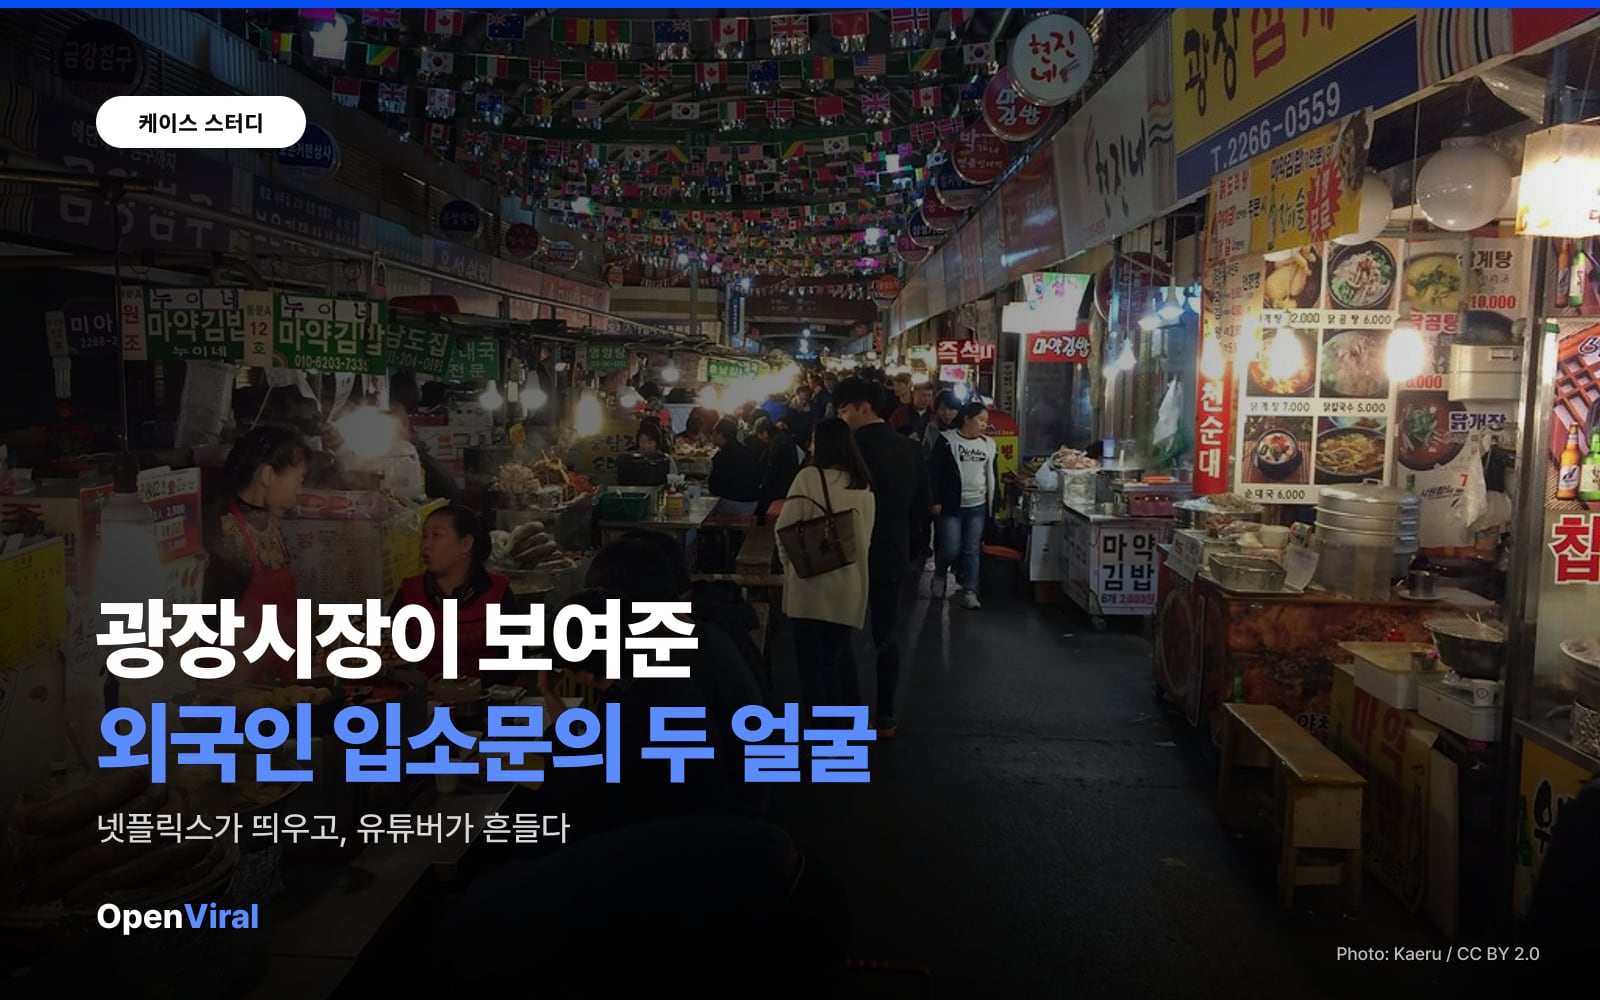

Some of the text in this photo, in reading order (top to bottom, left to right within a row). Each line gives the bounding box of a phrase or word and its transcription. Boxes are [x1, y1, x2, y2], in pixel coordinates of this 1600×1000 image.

[63, 41, 133, 73] 금강침구
[1210, 81, 1340, 174] T.2266-0559
[152, 287, 240, 310] 누이네
[282, 295, 372, 324] 누이네
[122, 304, 142, 352] 원조
[1260, 312, 1282, 324] 계탕
[171, 345, 228, 358] 누이네
[279, 318, 385, 358] 마약김밥
[387, 323, 449, 358] 남도집
[449, 362, 486, 379] 전문
[1276, 488, 1306, 500] 6.000
[1103, 534, 1156, 562] 마약
[1102, 563, 1155, 591] 김밥
